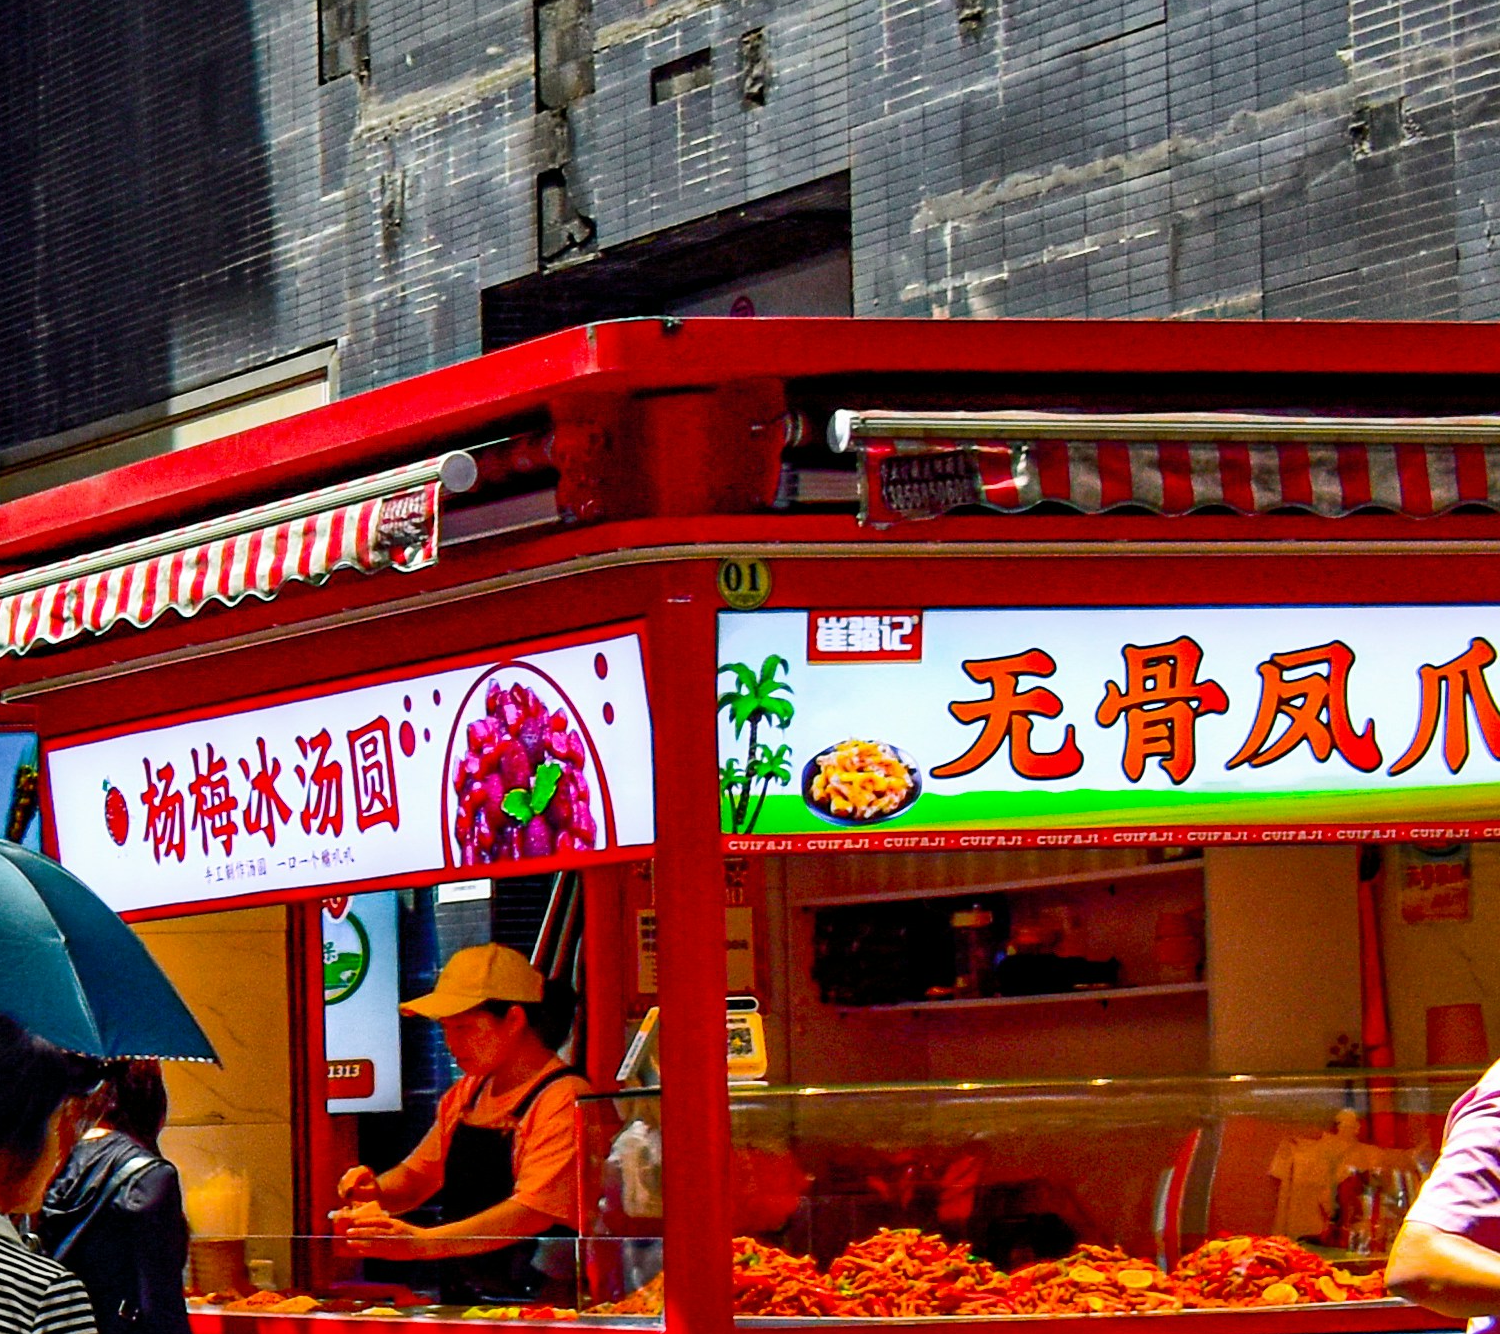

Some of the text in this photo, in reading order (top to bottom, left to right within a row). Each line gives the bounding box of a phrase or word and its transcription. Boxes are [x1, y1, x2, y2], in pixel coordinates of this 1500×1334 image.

[723, 563, 760, 593] 01
[929, 635, 1500, 785] 无骨凤爪
[140, 713, 401, 867] 杨梅冰汤圆
